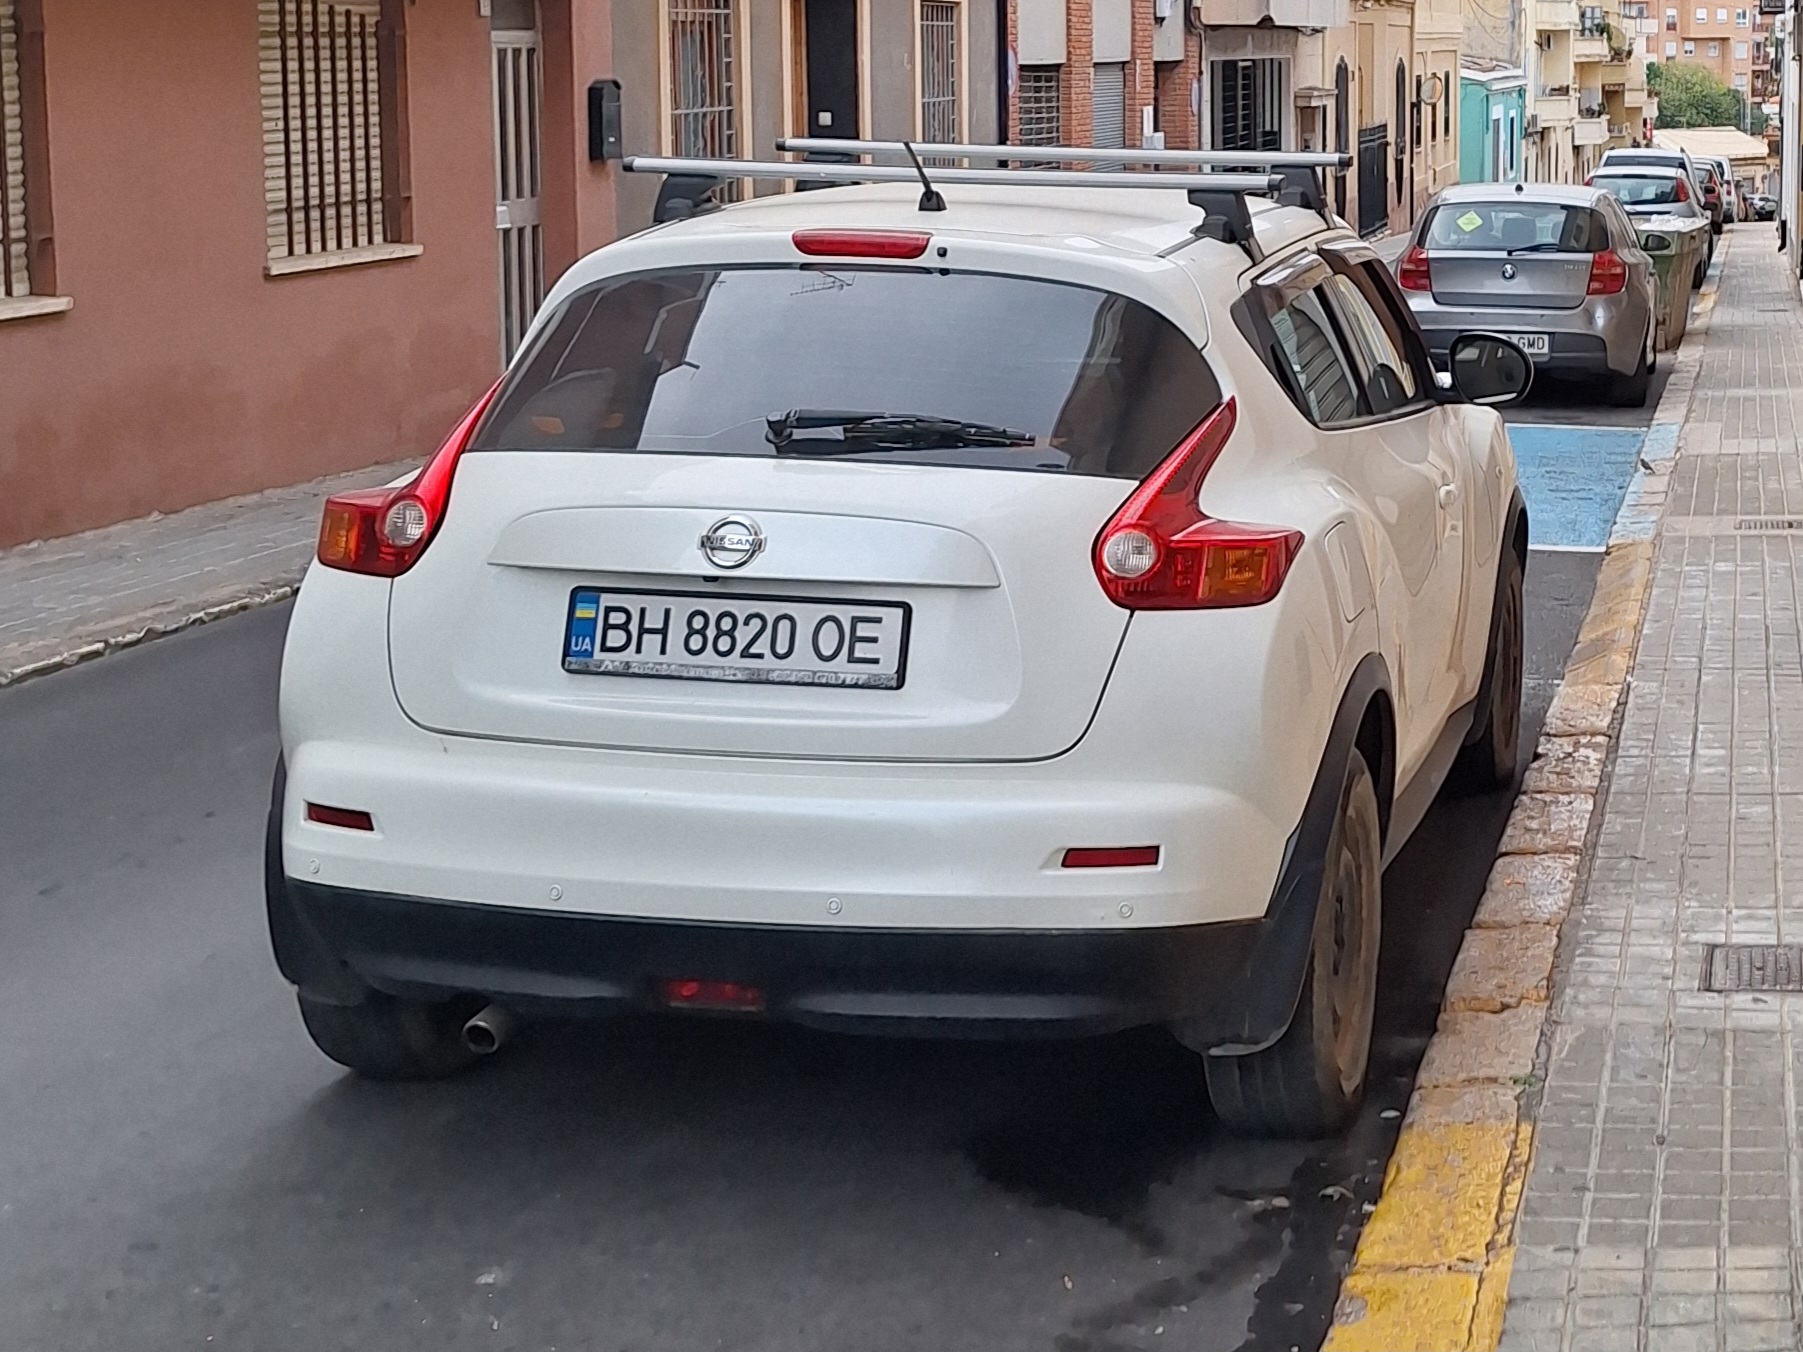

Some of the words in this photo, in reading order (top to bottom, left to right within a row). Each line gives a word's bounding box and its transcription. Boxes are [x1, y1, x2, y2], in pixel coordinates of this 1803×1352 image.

[1517, 336, 1545, 350] GMD
[706, 535, 754, 547] NISSAN
[599, 605, 672, 656] BH
[683, 609, 797, 661] 8820
[811, 614, 883, 665] OE
[571, 635, 592, 652] UA
